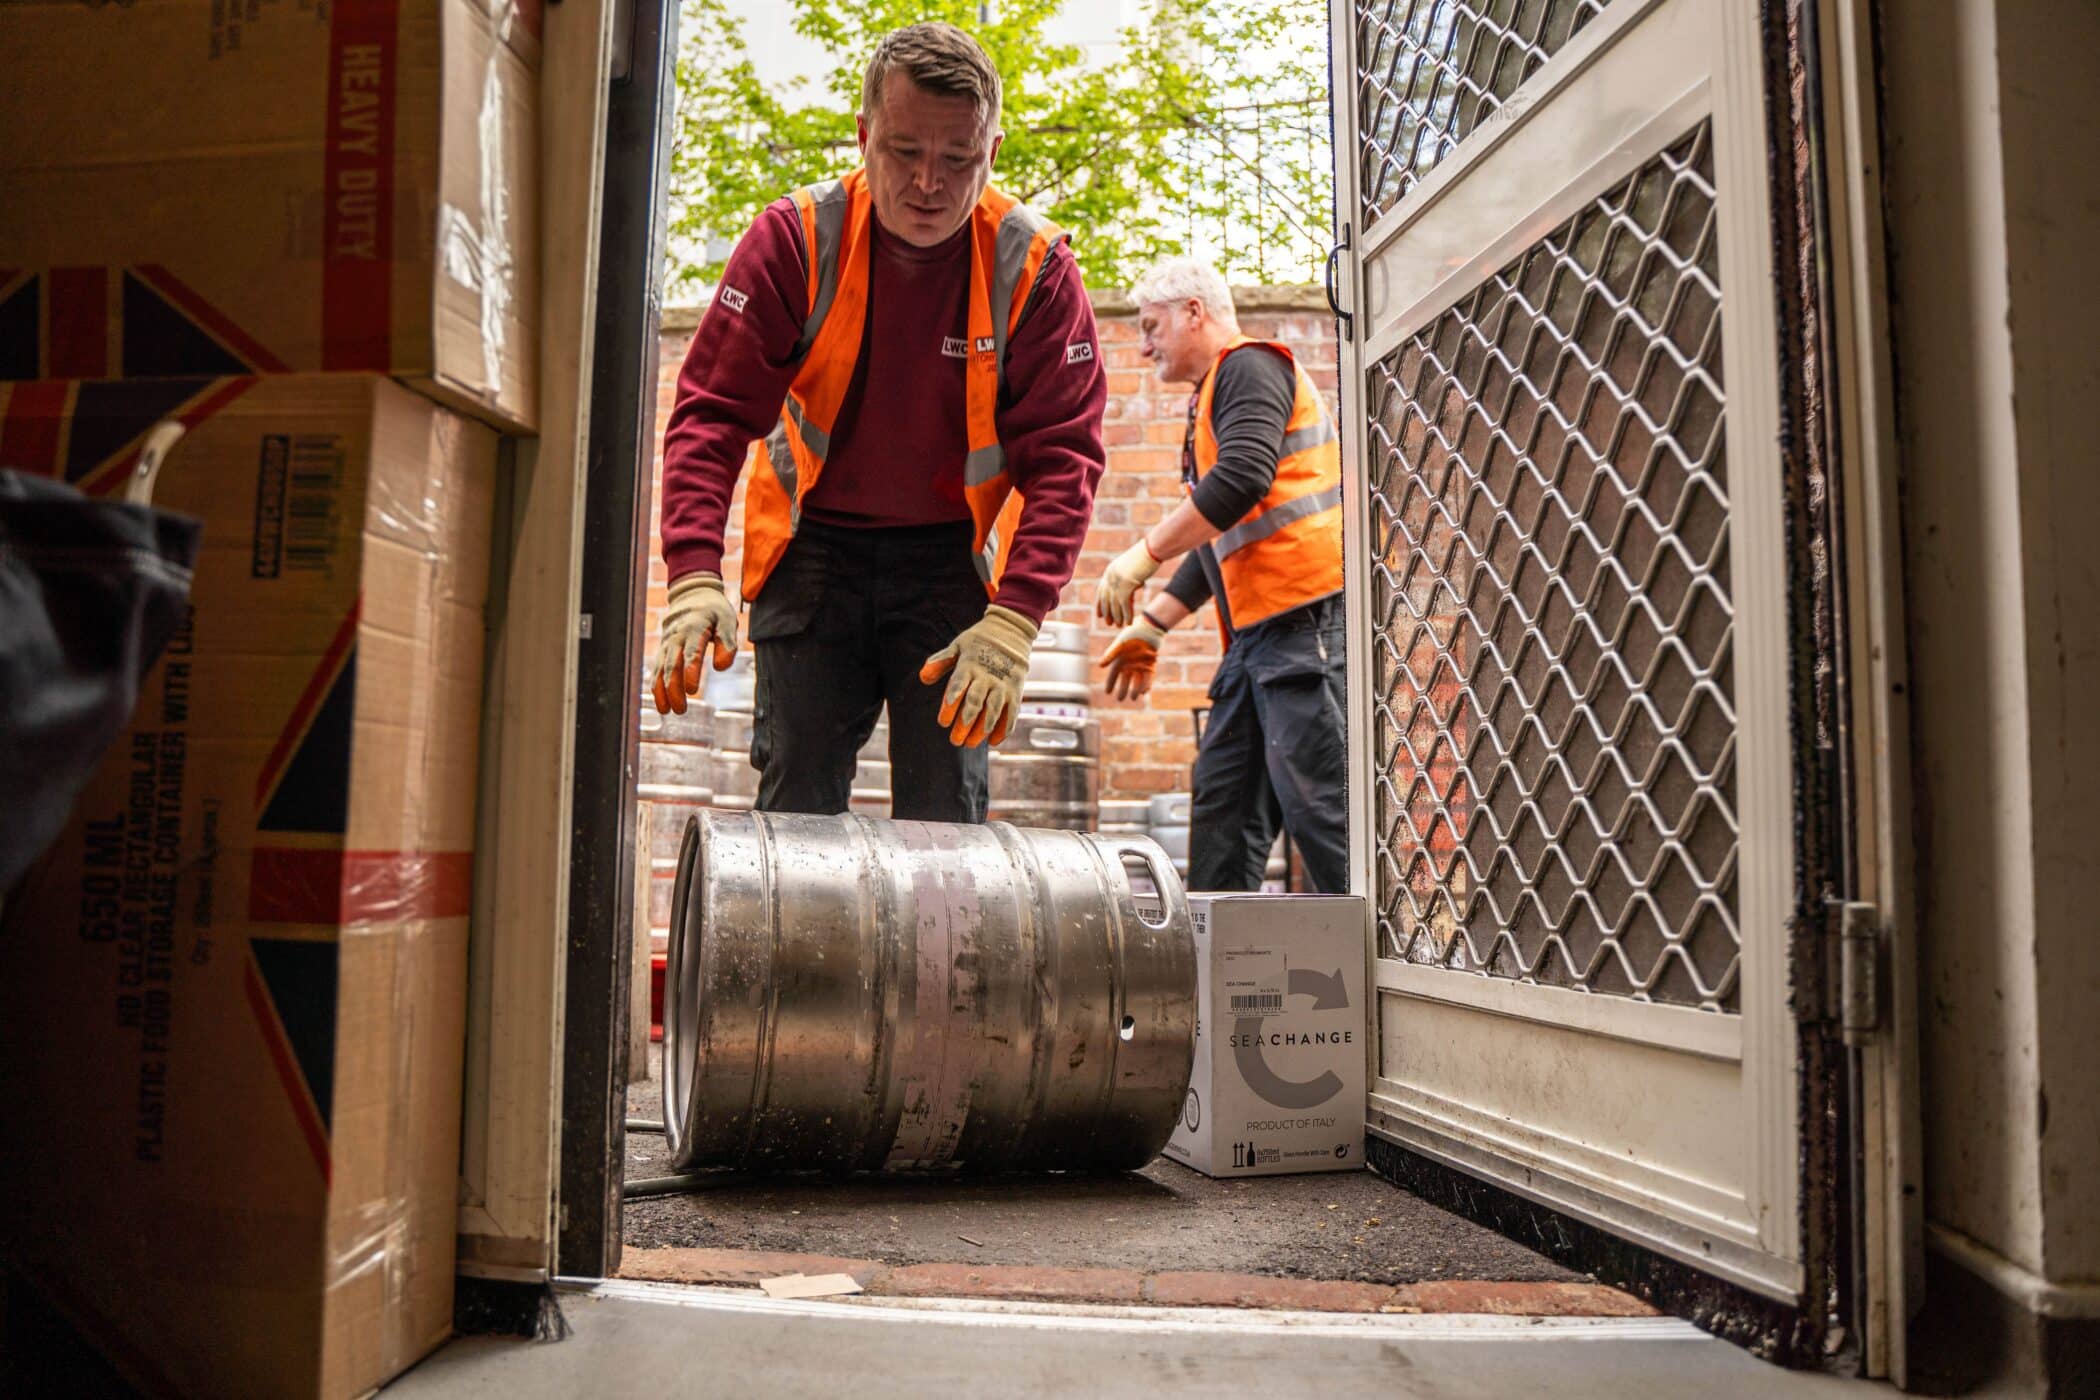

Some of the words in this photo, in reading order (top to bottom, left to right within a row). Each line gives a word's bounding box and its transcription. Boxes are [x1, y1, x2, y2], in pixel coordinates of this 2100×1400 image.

[340, 44, 381, 155] HEAVY
[337, 168, 377, 261] DUTY
[723, 288, 745, 309] LWC
[944, 339, 968, 355] LWC
[976, 337, 995, 352] LW
[162, 663, 190, 723] WITH
[124, 730, 159, 902] RECTANGULAR
[155, 731, 186, 864] CONTAINER
[84, 812, 126, 866] ML
[79, 874, 121, 943] 650
[145, 873, 178, 982] STORAGE
[119, 911, 146, 986] CLEAR
[142, 989, 172, 1053] FOOD
[1229, 1031, 1353, 1048] SEACHANGE
[136, 1063, 167, 1162] PLASTIC
[1246, 1119, 1295, 1132] PRODUCT
[1296, 1118, 1311, 1129] OF
[1312, 1117, 1336, 1128] ITALY
